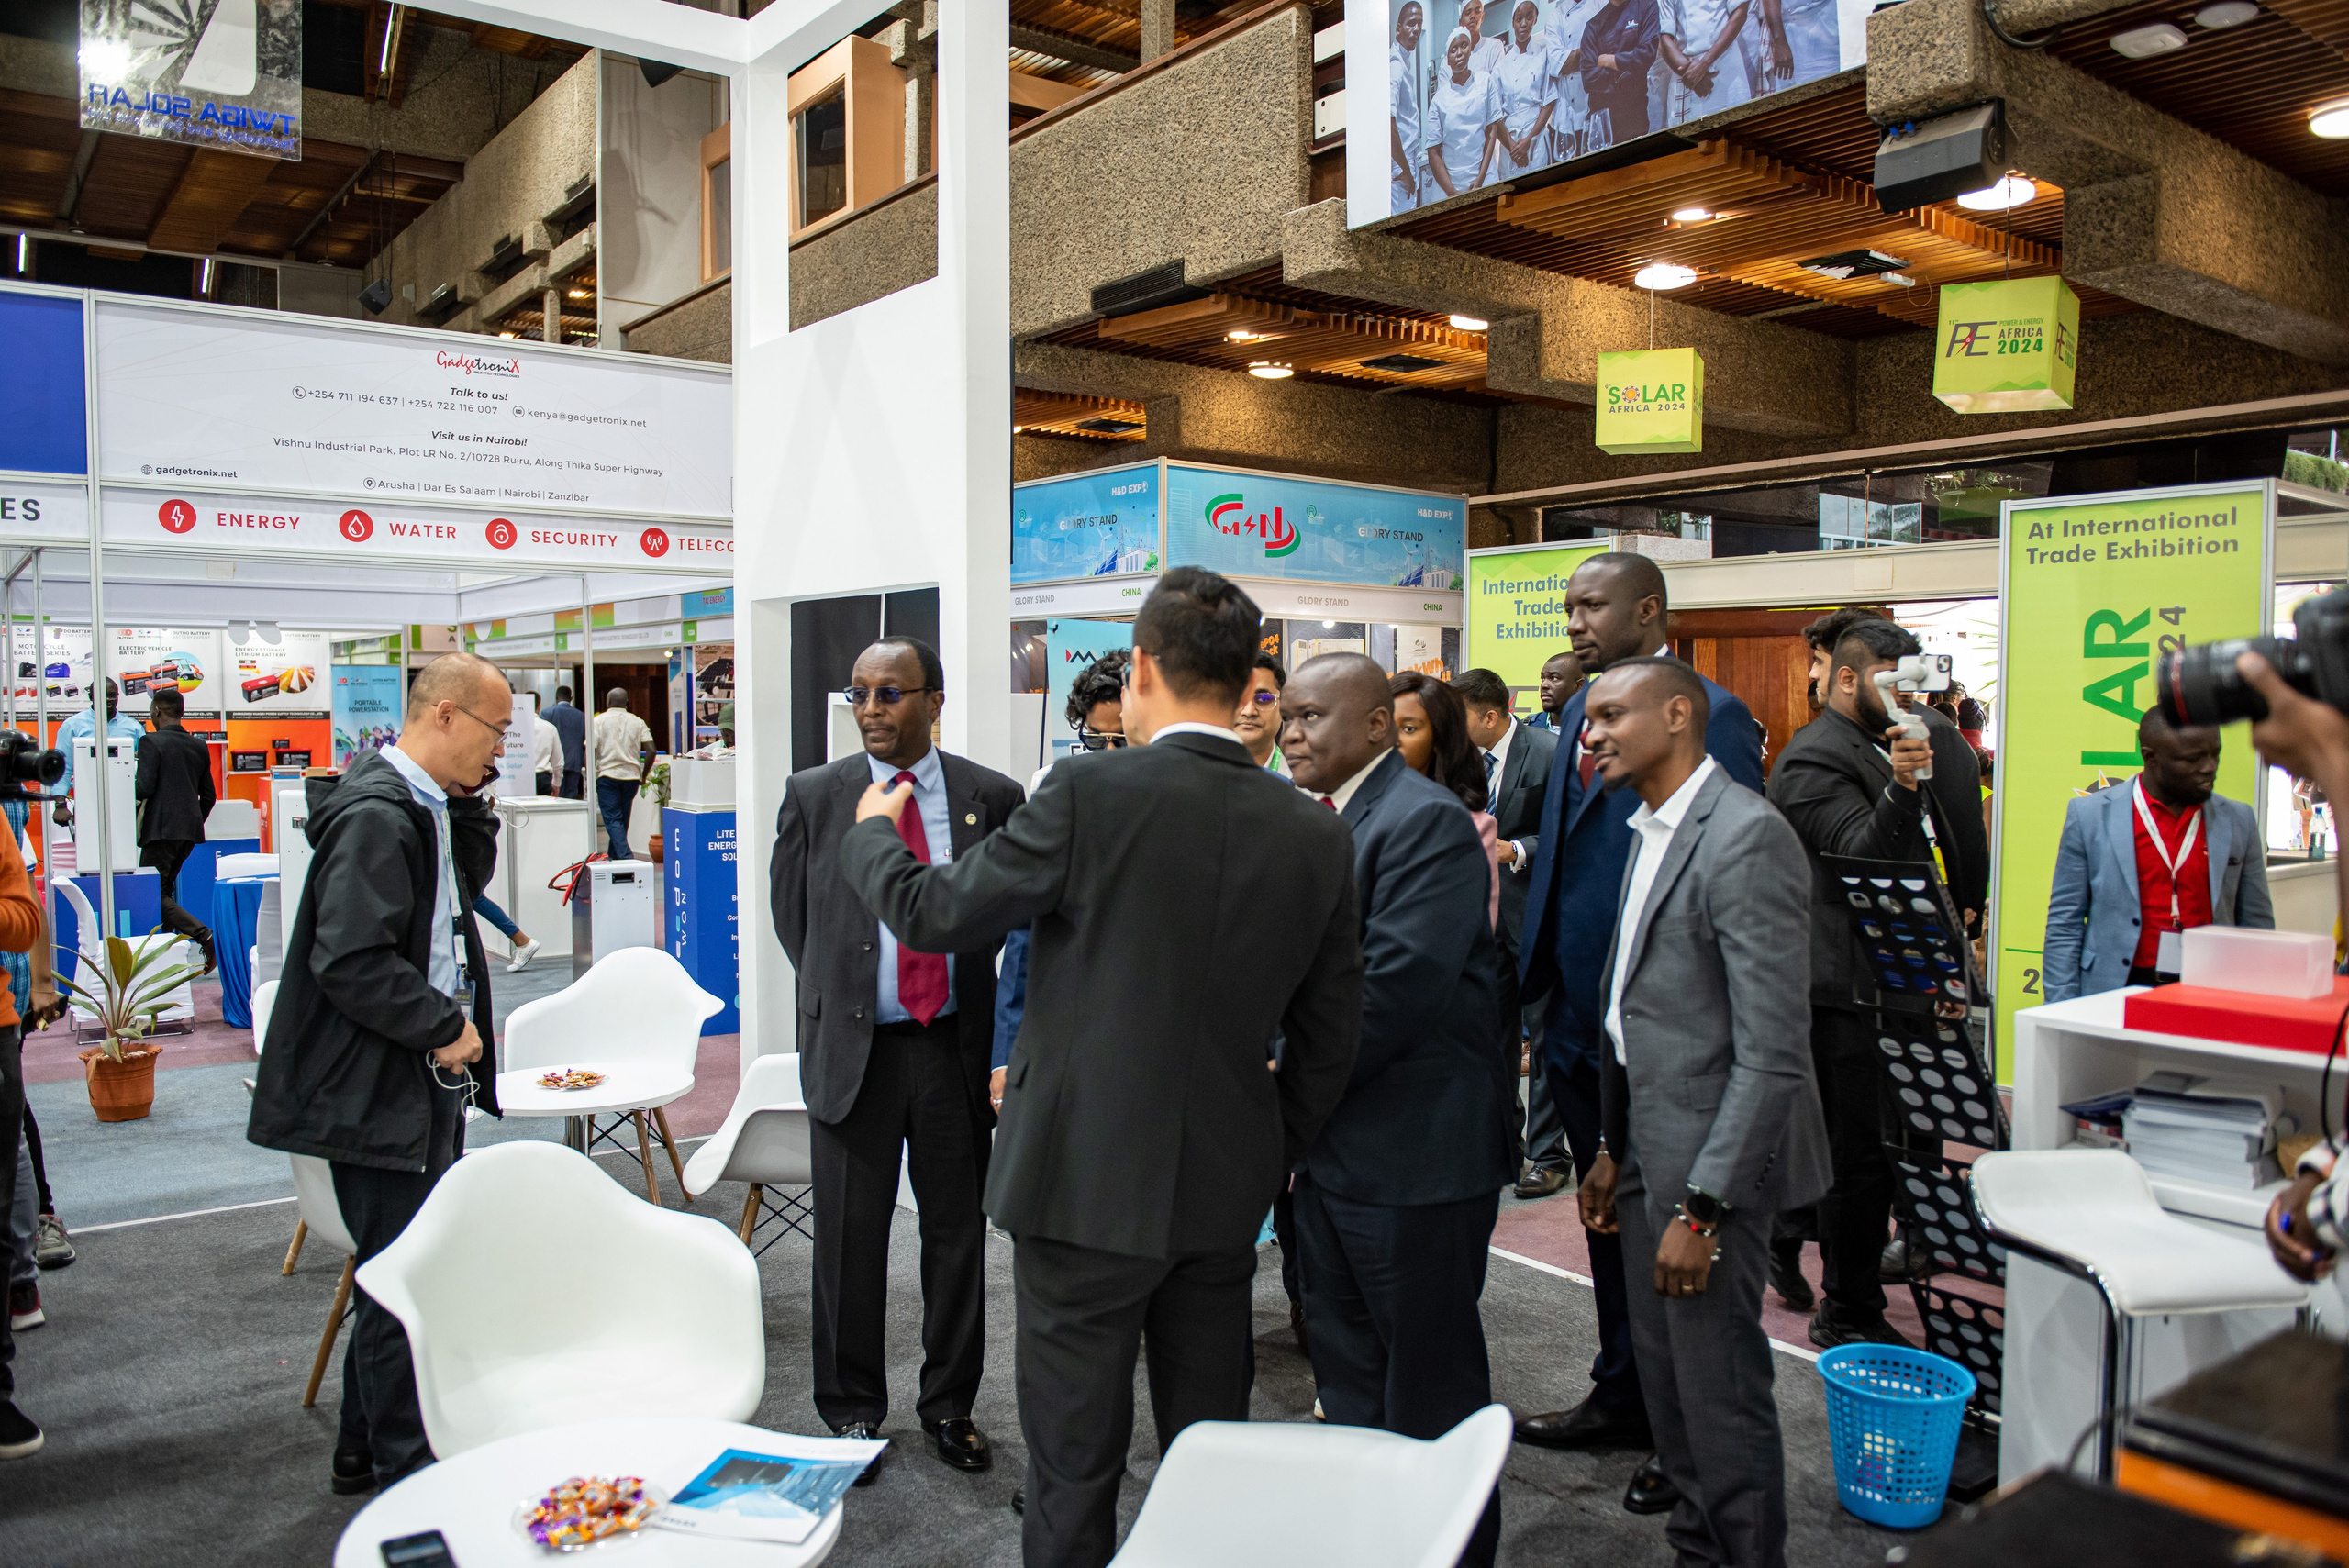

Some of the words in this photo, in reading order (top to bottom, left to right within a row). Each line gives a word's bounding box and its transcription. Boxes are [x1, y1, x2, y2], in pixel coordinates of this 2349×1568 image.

[1998, 327, 2043, 339] AFRICA
[1997, 338, 2043, 355] 2024
[308, 389, 334, 400] +254
[339, 392, 353, 402] 711
[358, 394, 374, 404] 194
[379, 395, 398, 406] 637
[409, 399, 433, 408] +254
[437, 402, 456, 411] 722
[459, 404, 473, 412] 116
[477, 406, 497, 415] 007
[451, 387, 473, 398] Talk
[477, 391, 488, 399] to
[492, 393, 508, 401] us!
[1609, 404, 1650, 414] AFRICA
[1657, 403, 1686, 411] 2024
[528, 408, 646, 428] kenya@gadgetronix.net
[431, 431, 455, 440] Visit
[473, 434, 483, 442] in
[486, 436, 528, 446] Nairobi!
[273, 437, 311, 448] Vishnu
[315, 440, 365, 452] Industrial
[399, 447, 420, 457] Plot
[423, 450, 436, 458] LR
[440, 450, 457, 460] No.
[460, 452, 500, 462] 2/10728
[535, 459, 563, 469] Along
[566, 461, 591, 470] Thika
[594, 462, 620, 473] Super
[624, 465, 663, 477] Highway
[156, 464, 238, 479] gadgetronix.net
[378, 480, 415, 490] Arusha
[424, 483, 441, 492] Dar
[445, 484, 456, 493] Es
[459, 485, 495, 495] Salaam
[505, 489, 540, 499] Nairobi
[548, 492, 589, 502] Zanzibar
[1111, 486, 1127, 495] H&D
[217, 512, 301, 530] ENERGY
[1417, 508, 1433, 517] H&D
[389, 522, 457, 539] WATER
[1060, 516, 1086, 531] GLORY
[1089, 514, 1118, 528] STAND
[2027, 521, 2054, 539] At
[2063, 506, 2237, 538] International
[531, 530, 618, 547] SECURITY
[1358, 527, 1390, 539] GLORY
[1393, 530, 1424, 542] STAND
[2026, 543, 2096, 565] Trade
[2106, 536, 2239, 561] Exhibition
[1121, 587, 1141, 597] CHINA
[1483, 574, 1568, 595] Internatio
[1015, 596, 1033, 606] GLORY
[1035, 595, 1055, 604] STAND
[1297, 596, 1323, 606] GLORY
[1325, 597, 1349, 607] STAND
[1423, 604, 1442, 612] CHINA
[1514, 598, 1564, 616] Trade
[1497, 621, 1570, 639] Exhibitio
[708, 841, 737, 850] ENERG
